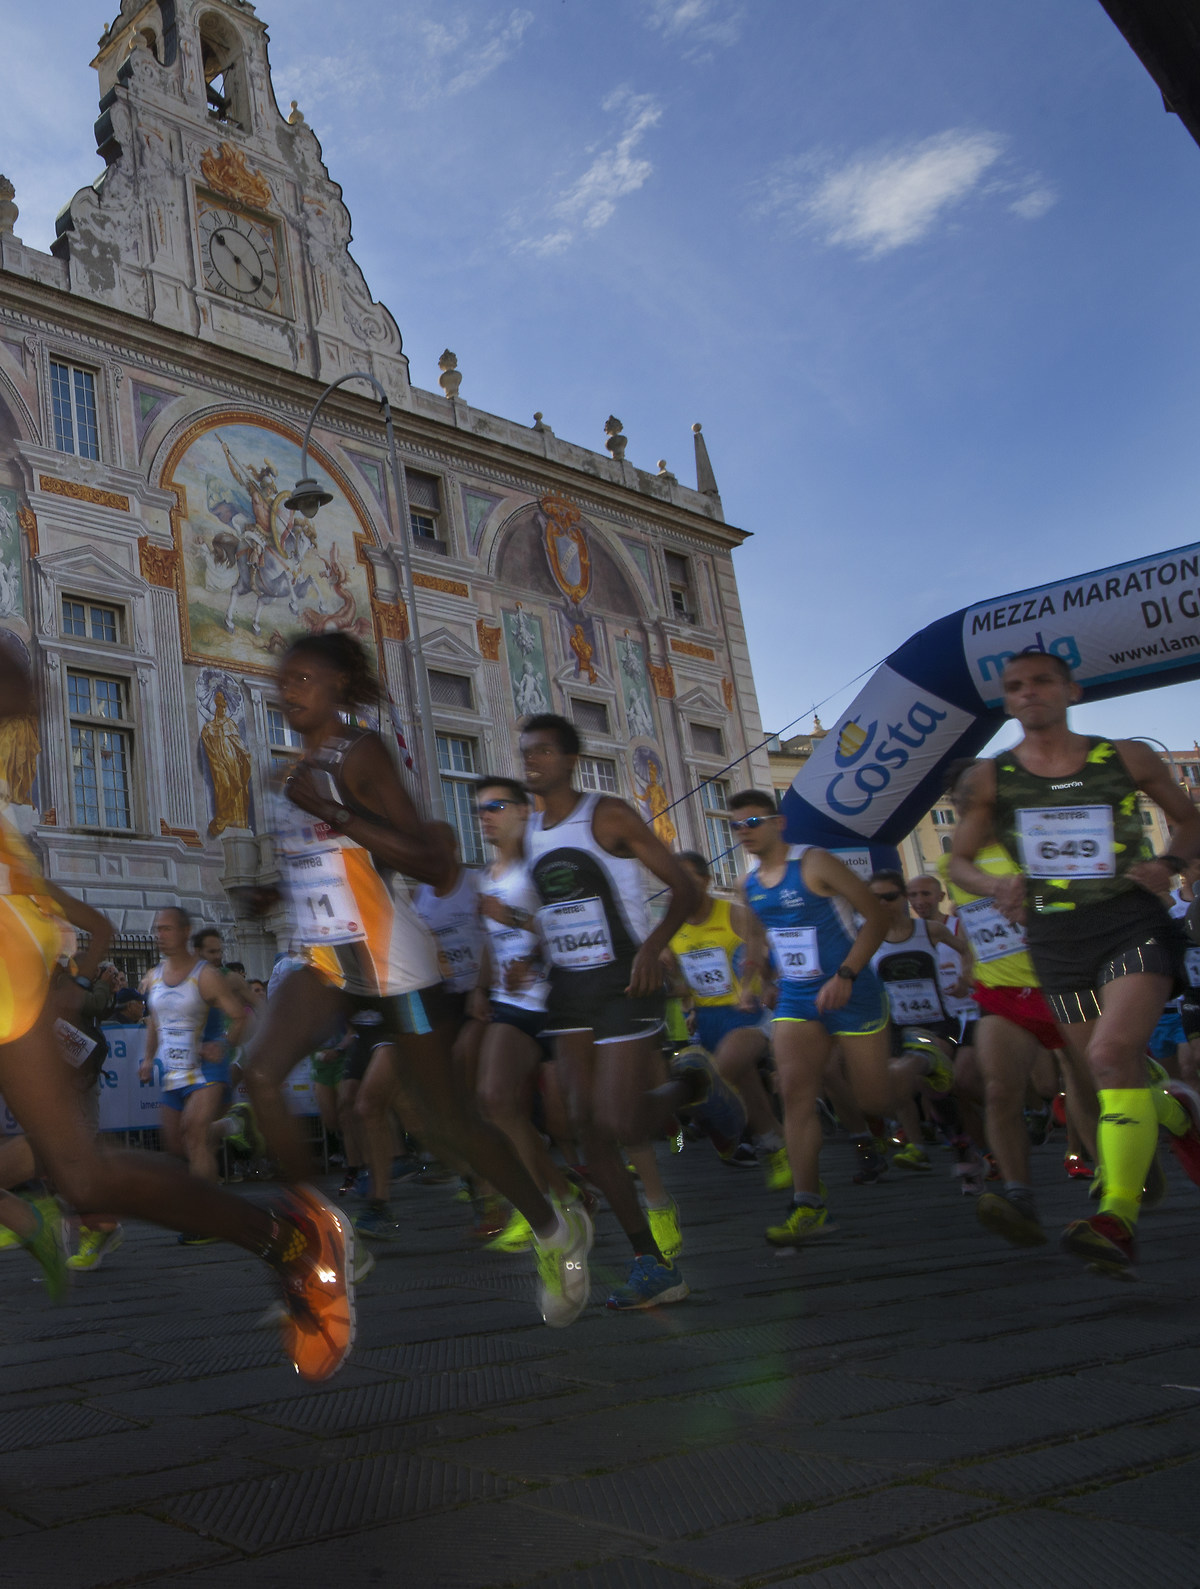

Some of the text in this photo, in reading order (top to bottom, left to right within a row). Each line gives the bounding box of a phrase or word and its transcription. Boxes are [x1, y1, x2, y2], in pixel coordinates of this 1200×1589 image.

[971, 595, 1056, 636] MEZZA
[1141, 589, 1200, 629] DI G
[826, 701, 947, 816] Costa
[1051, 781, 1084, 791] macron
[841, 857, 868, 866] utobi
[1038, 840, 1100, 860] 649
[552, 929, 608, 953] 1844
